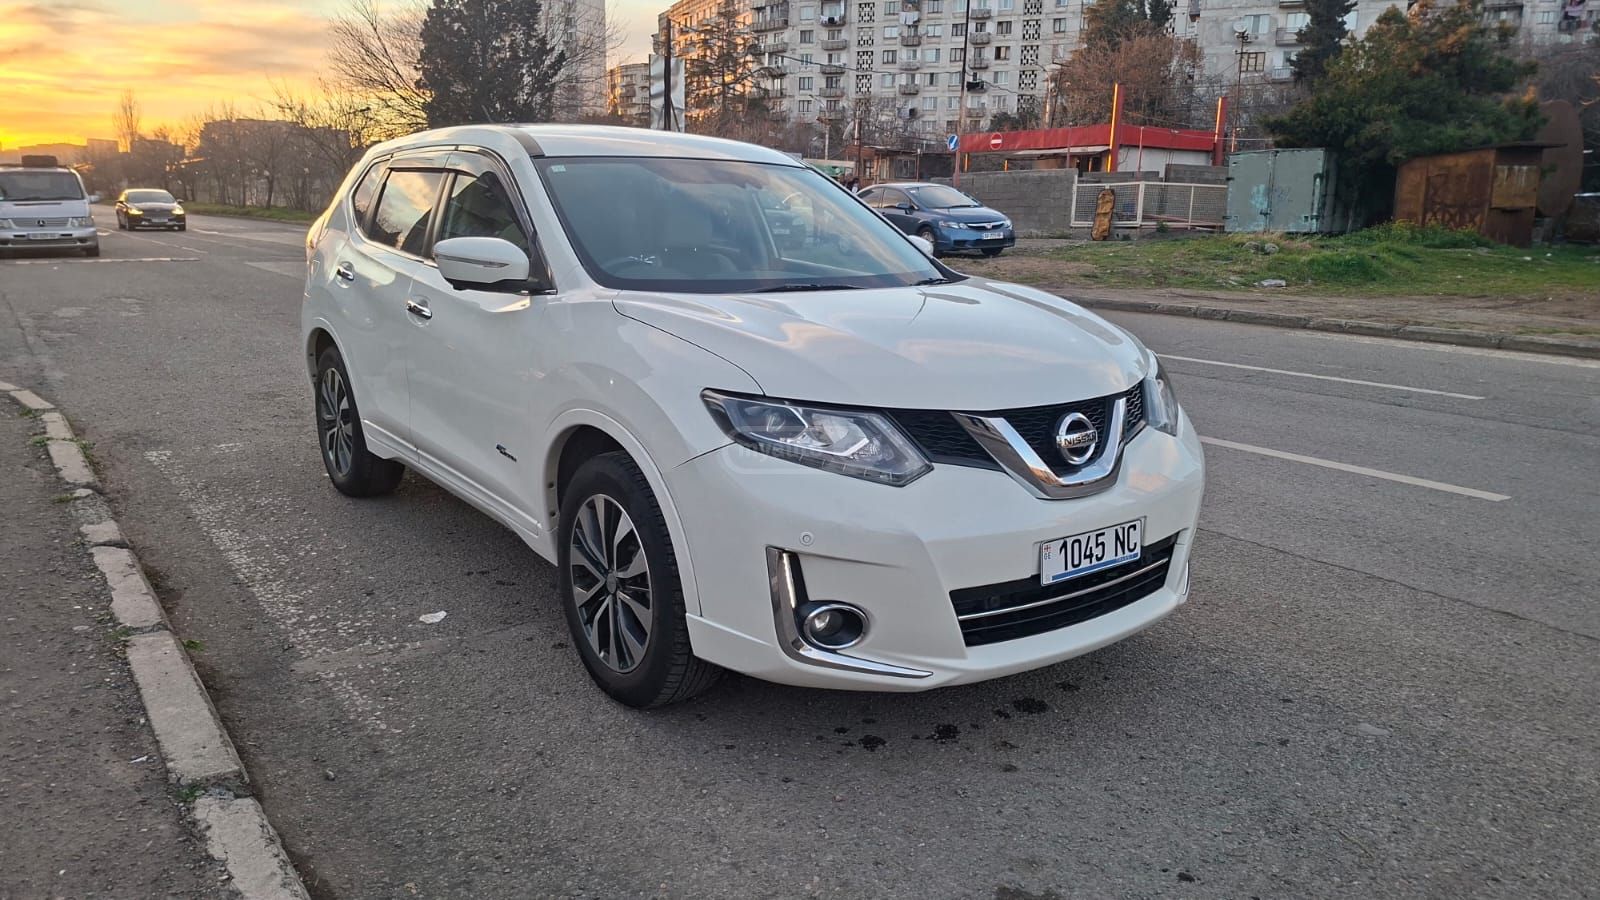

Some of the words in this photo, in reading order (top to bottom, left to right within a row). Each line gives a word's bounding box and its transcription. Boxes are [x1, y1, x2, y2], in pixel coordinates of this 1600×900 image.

[1043, 552, 1051, 560] GE
[1059, 531, 1106, 571] 1045
[1114, 523, 1137, 557] NC
